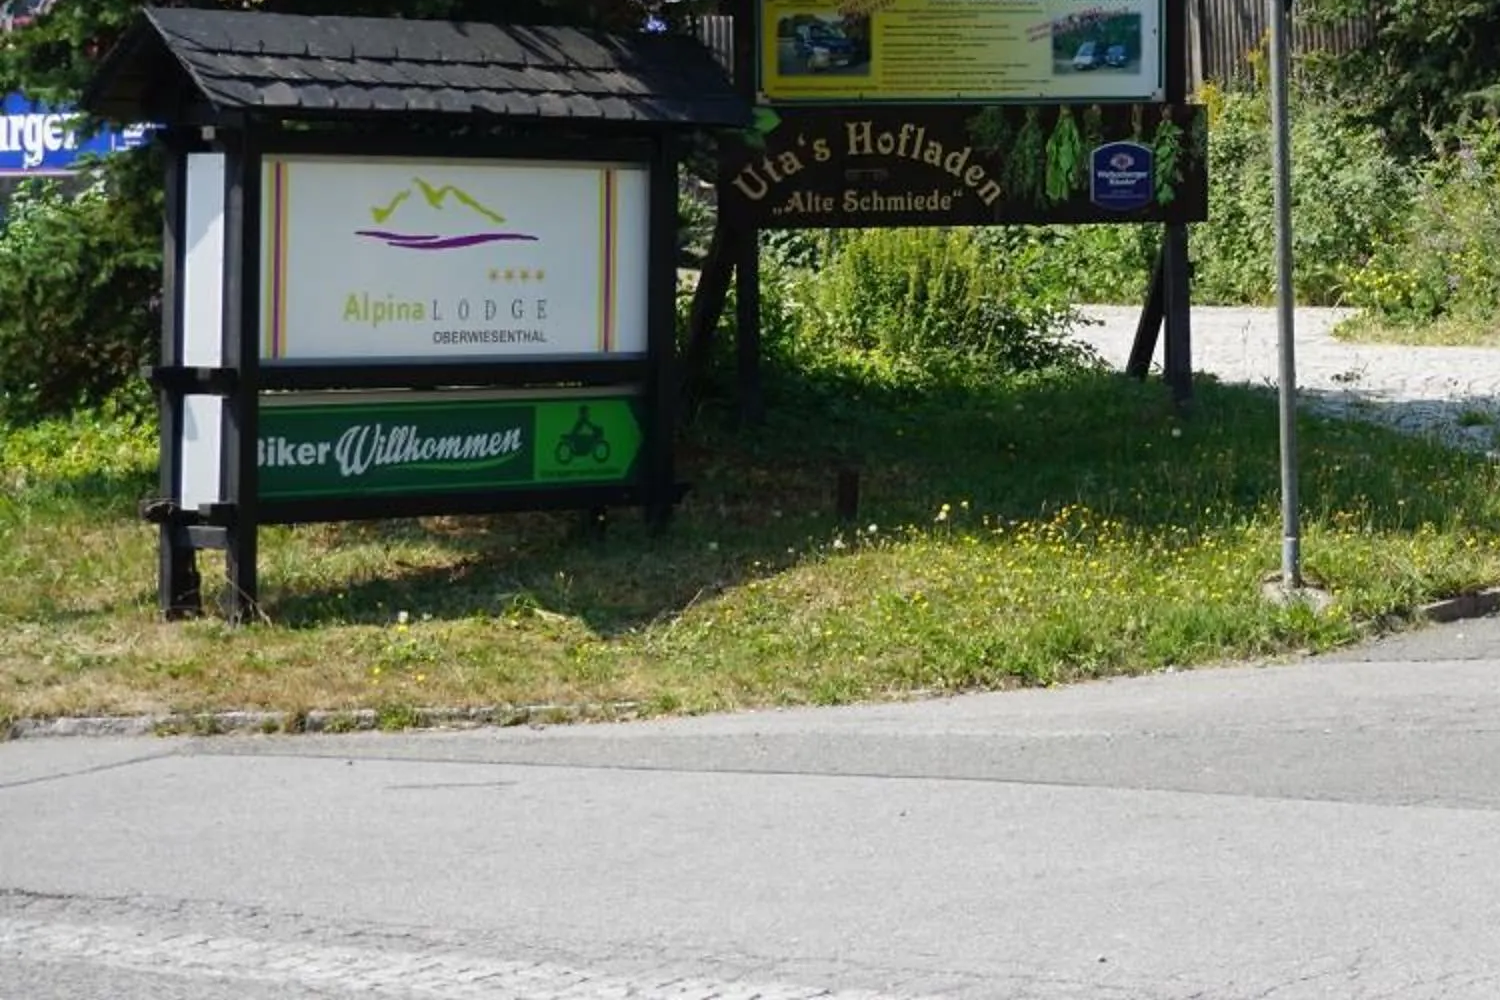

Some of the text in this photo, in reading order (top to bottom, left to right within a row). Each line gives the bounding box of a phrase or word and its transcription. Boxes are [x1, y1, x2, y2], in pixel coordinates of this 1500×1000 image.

[845, 120, 1001, 206] Hofladen
[343, 292, 549, 328] Alpina LODGE
[432, 329, 548, 344] OBERWIESENTHAL
[335, 423, 522, 477] Willkommen
